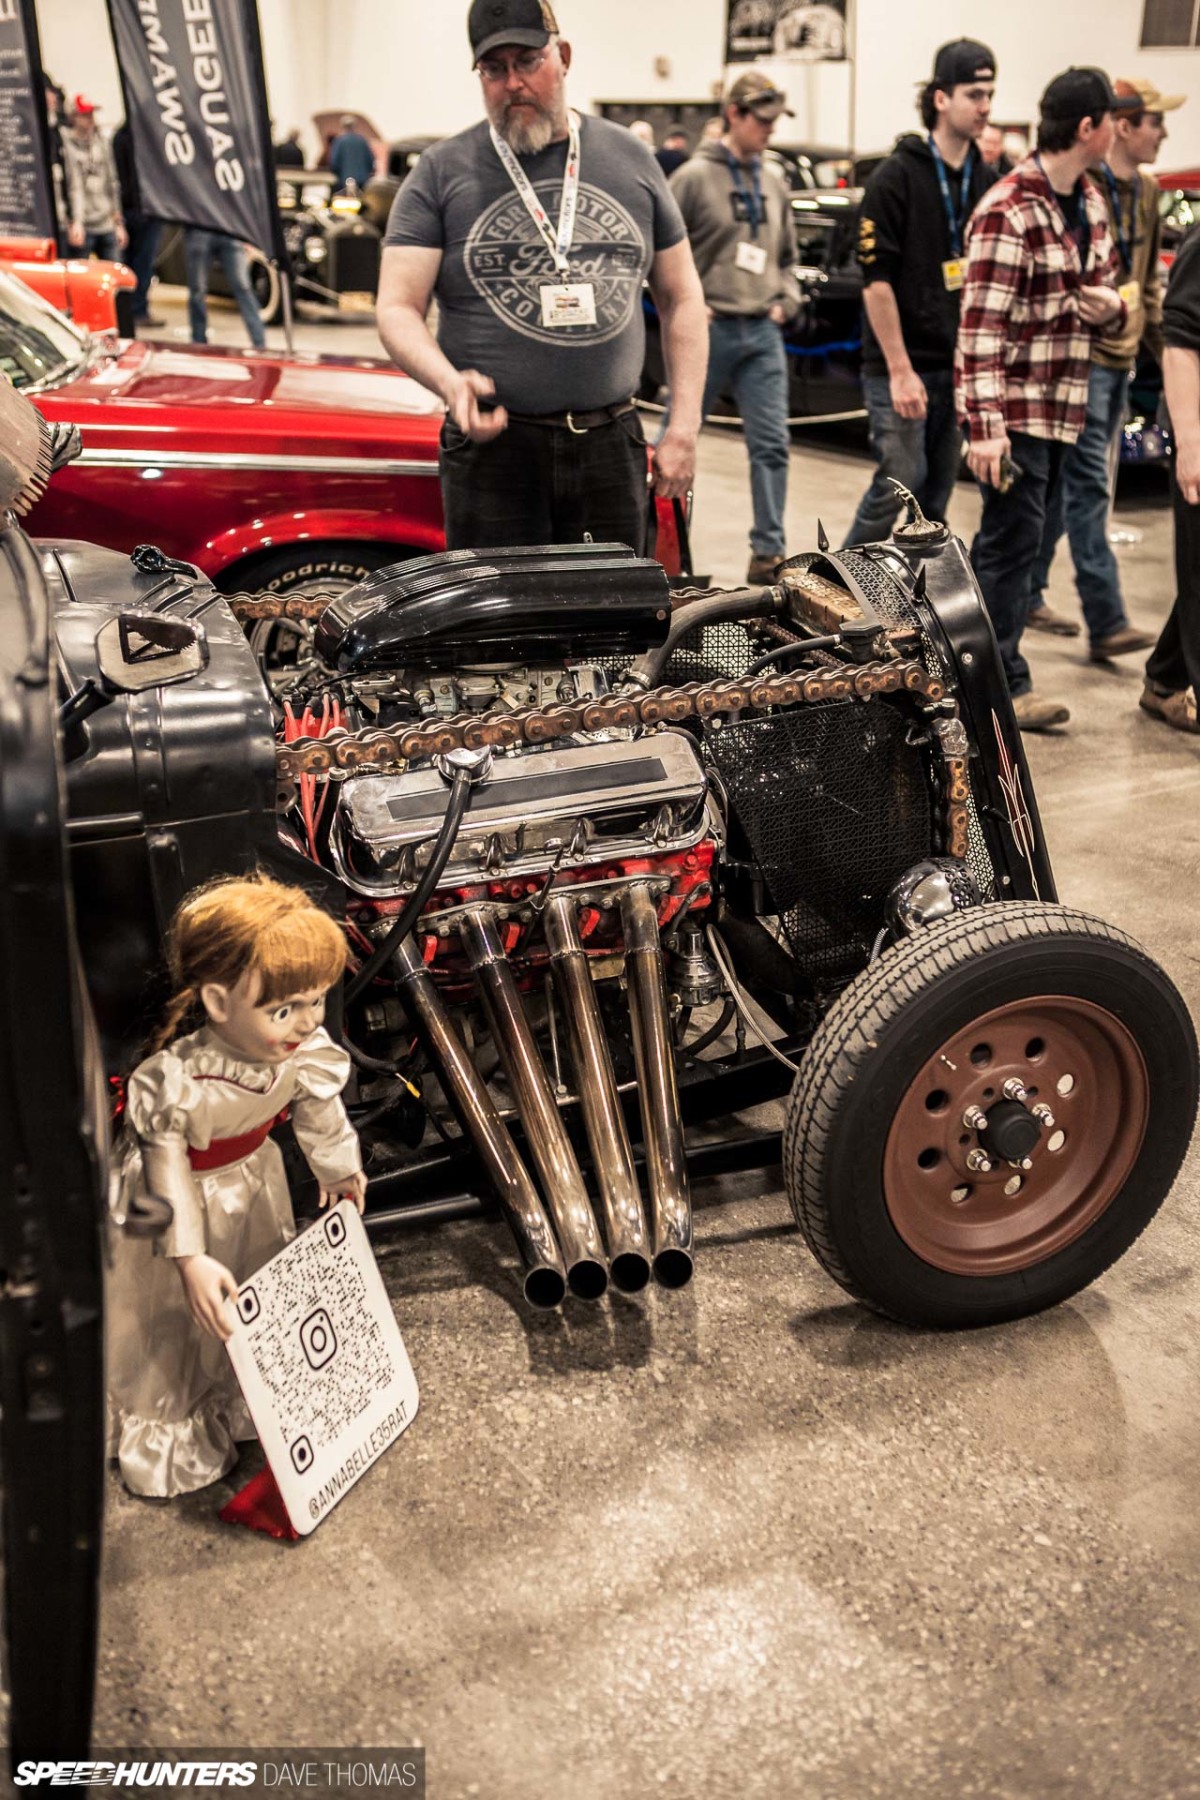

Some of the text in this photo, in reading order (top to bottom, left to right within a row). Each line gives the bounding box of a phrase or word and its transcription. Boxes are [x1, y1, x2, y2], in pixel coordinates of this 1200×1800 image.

[486, 204, 526, 240] FOR
[500, 288, 627, 333] CONY
[256, 562, 370, 594] oodrich
[309, 1400, 408, 1519] @ANNABELLE35RAT
